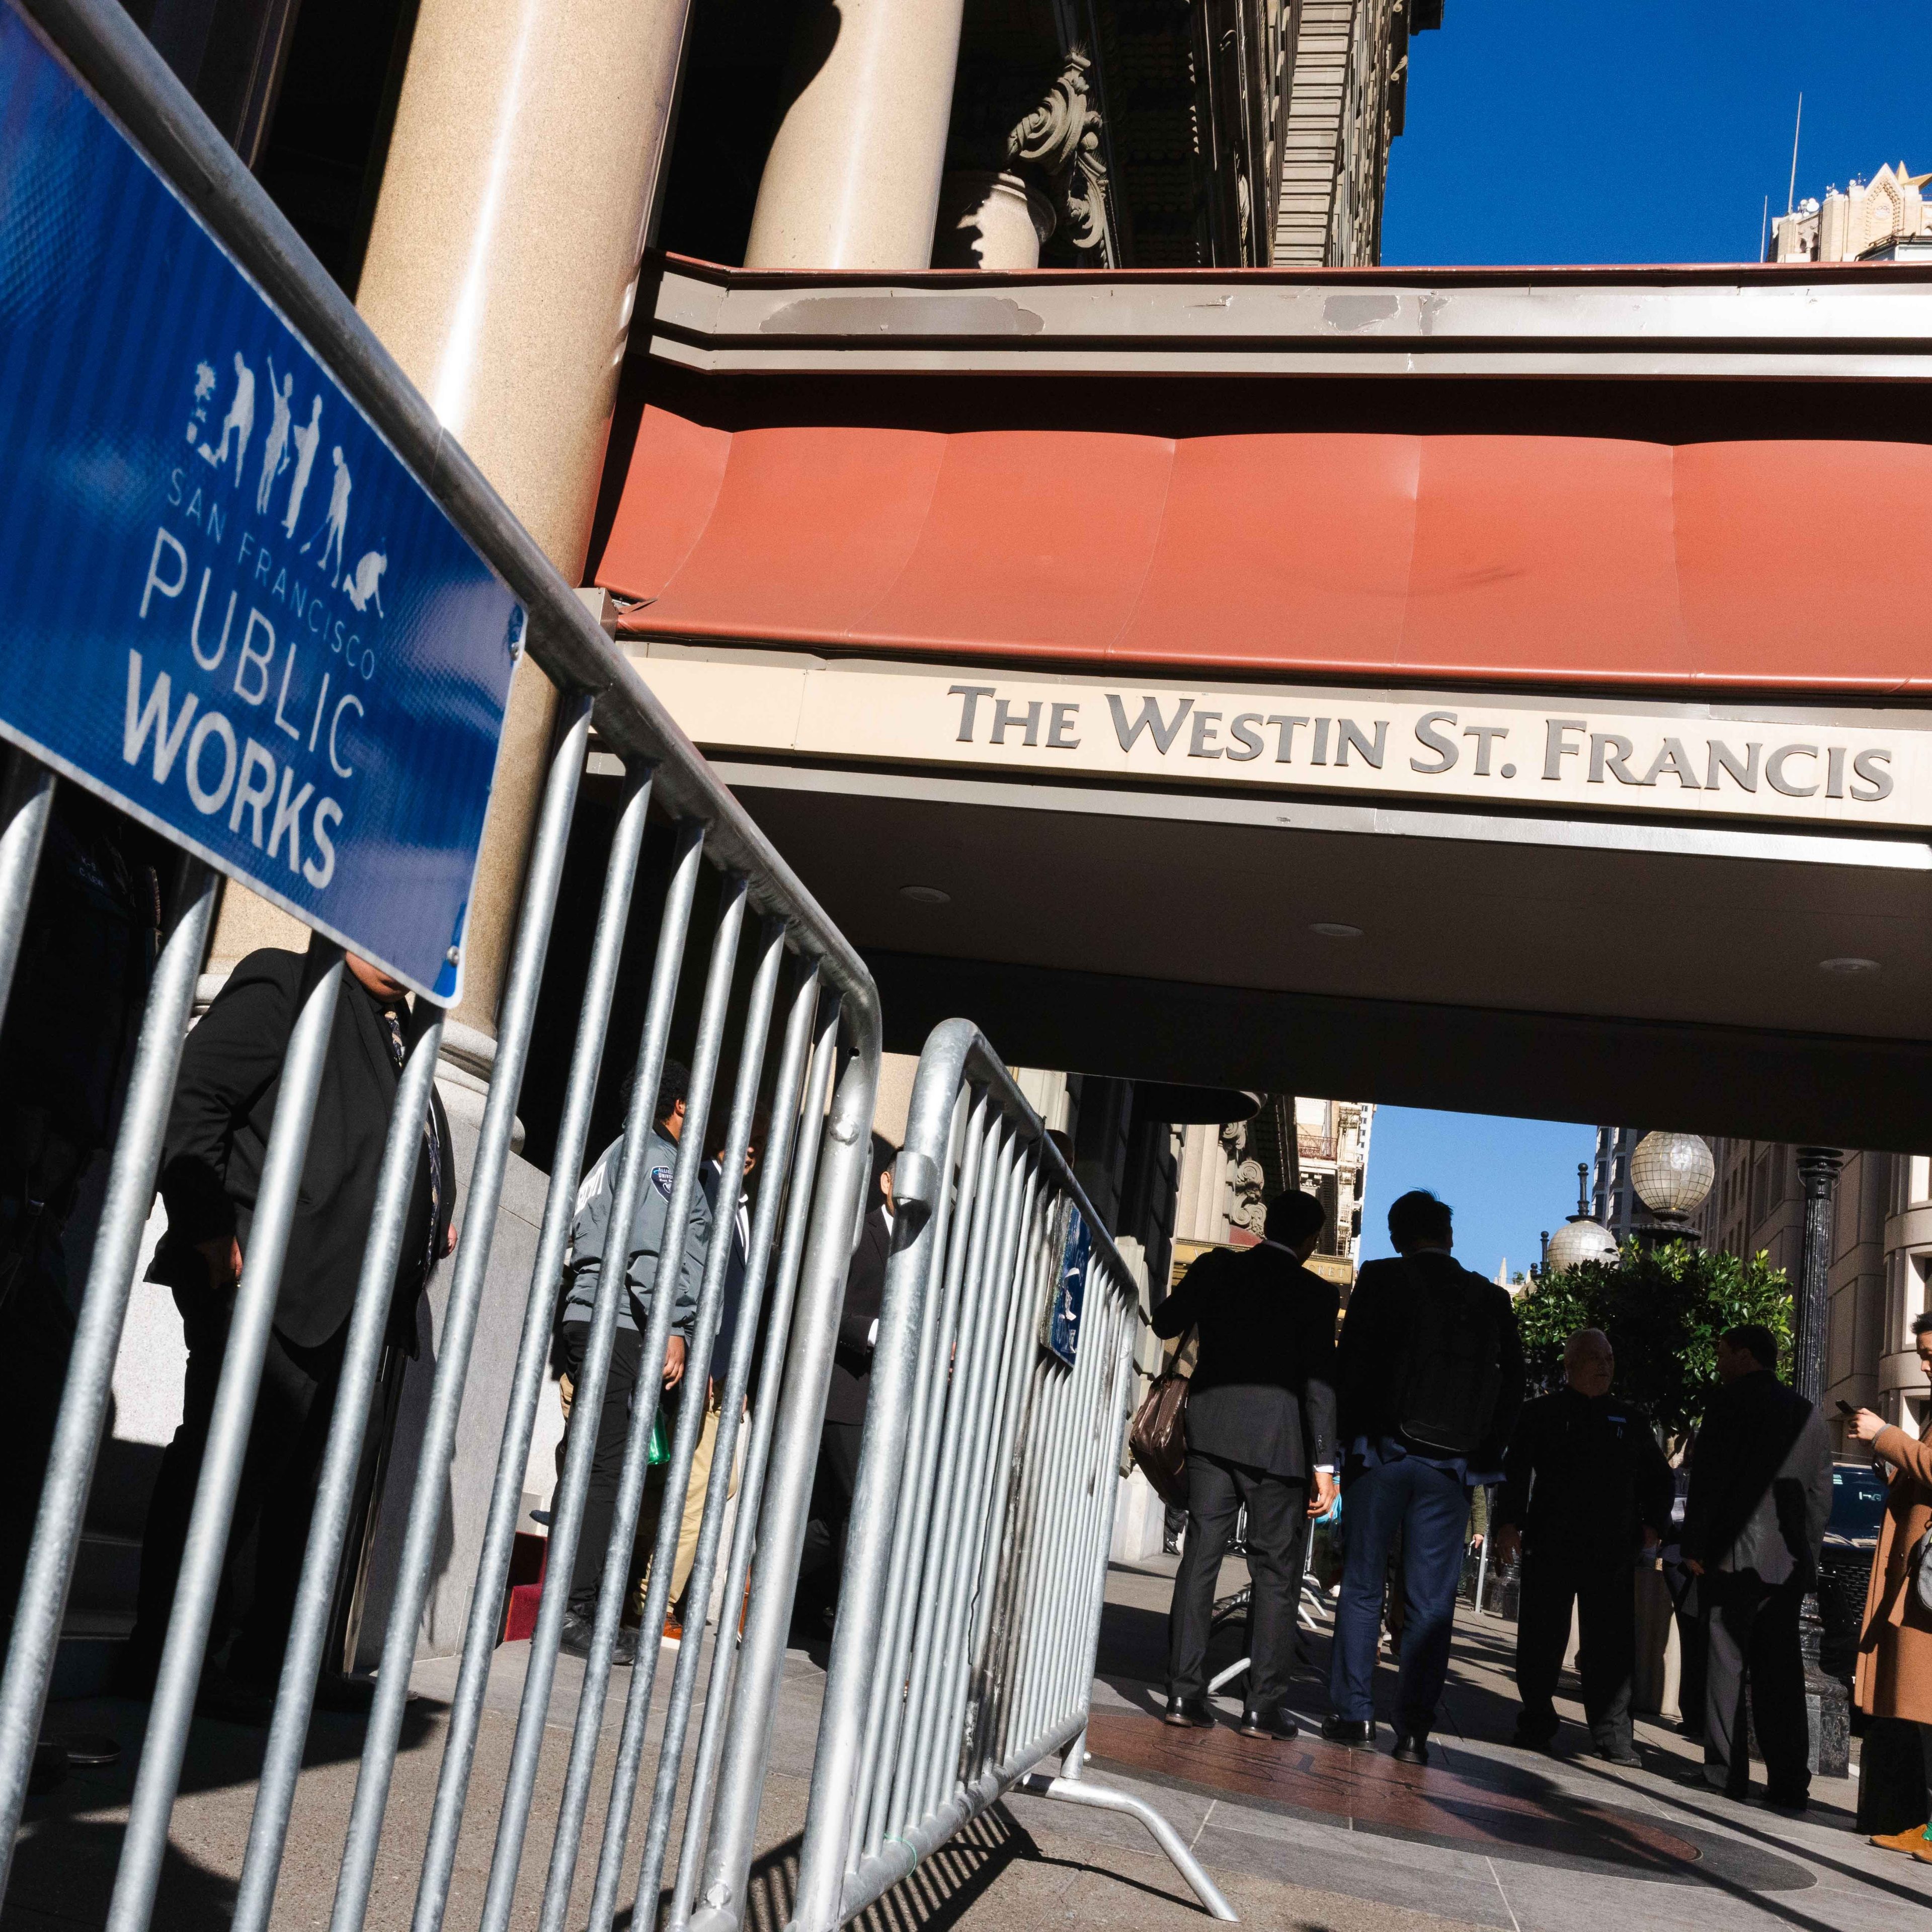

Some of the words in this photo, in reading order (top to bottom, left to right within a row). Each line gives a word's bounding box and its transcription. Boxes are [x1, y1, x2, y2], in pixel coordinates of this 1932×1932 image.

[139, 527, 364, 778] PUBLIC
[168, 468, 223, 544] SAN
[238, 531, 375, 682] FRANCISCO
[123, 648, 343, 890] WORKS
[948, 685, 1081, 749] THE
[1104, 693, 1389, 770] WESTIN
[1409, 711, 1517, 779] ST.
[1541, 718, 1895, 802] FRANCIS
[1307, 1264, 1346, 1278] CRET
